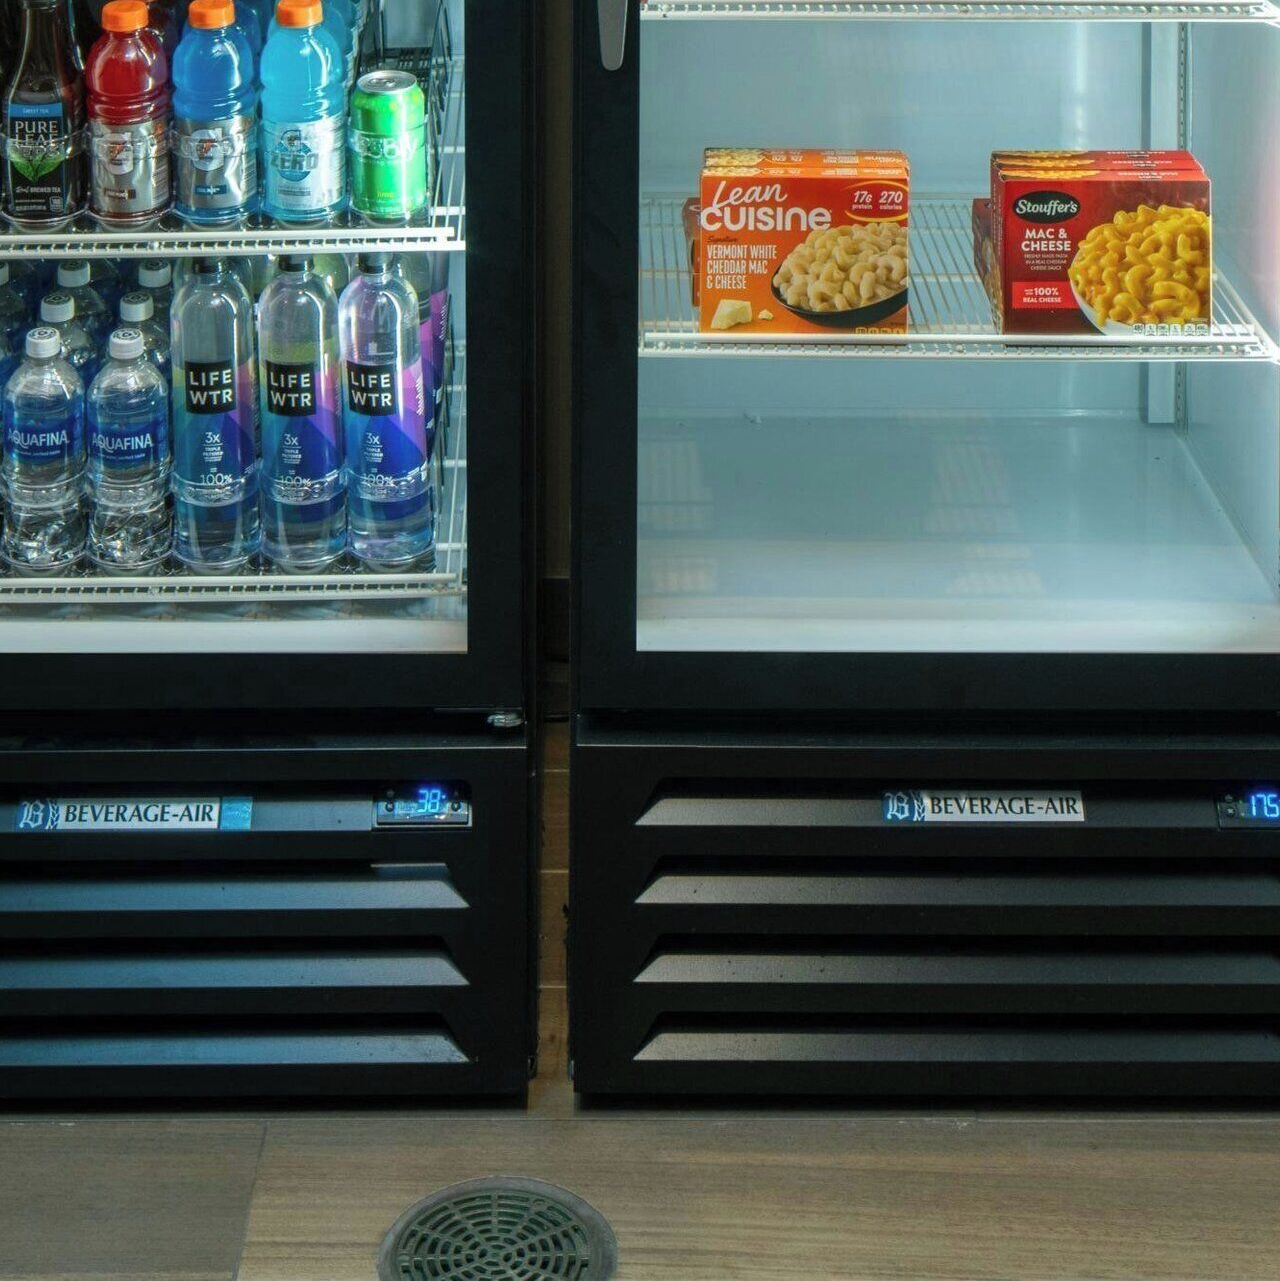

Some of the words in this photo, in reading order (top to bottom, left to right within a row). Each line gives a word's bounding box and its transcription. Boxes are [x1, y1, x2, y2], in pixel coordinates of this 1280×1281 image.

[15, 121, 58, 133] PURE
[712, 181, 788, 211] Lean
[879, 191, 903, 203] 270
[1016, 199, 1078, 216] Stouffer's
[1025, 229, 1054, 239] MAC
[1058, 229, 1067, 239] &
[707, 245, 748, 259] VERMONT
[750, 245, 777, 259] WHITE
[1021, 241, 1071, 251] CHEESE
[707, 261, 747, 274] CHEDDAR
[749, 261, 768, 274] MAC
[715, 276, 747, 289] CHEESE
[1033, 288, 1059, 296] 100%
[190, 369, 233, 386] LIFE
[270, 371, 310, 387] LIFE
[351, 371, 391, 387] LIFE
[190, 389, 233, 405] WTR
[270, 391, 312, 407] WTR
[351, 391, 392, 407] WTR
[7, 429, 68, 449] AQUAFINA
[92, 433, 153, 452] AQUAFINA
[64, 803, 214, 823] BEVERAGE-AIR
[931, 797, 1079, 816] BEVERAGE-AIR
